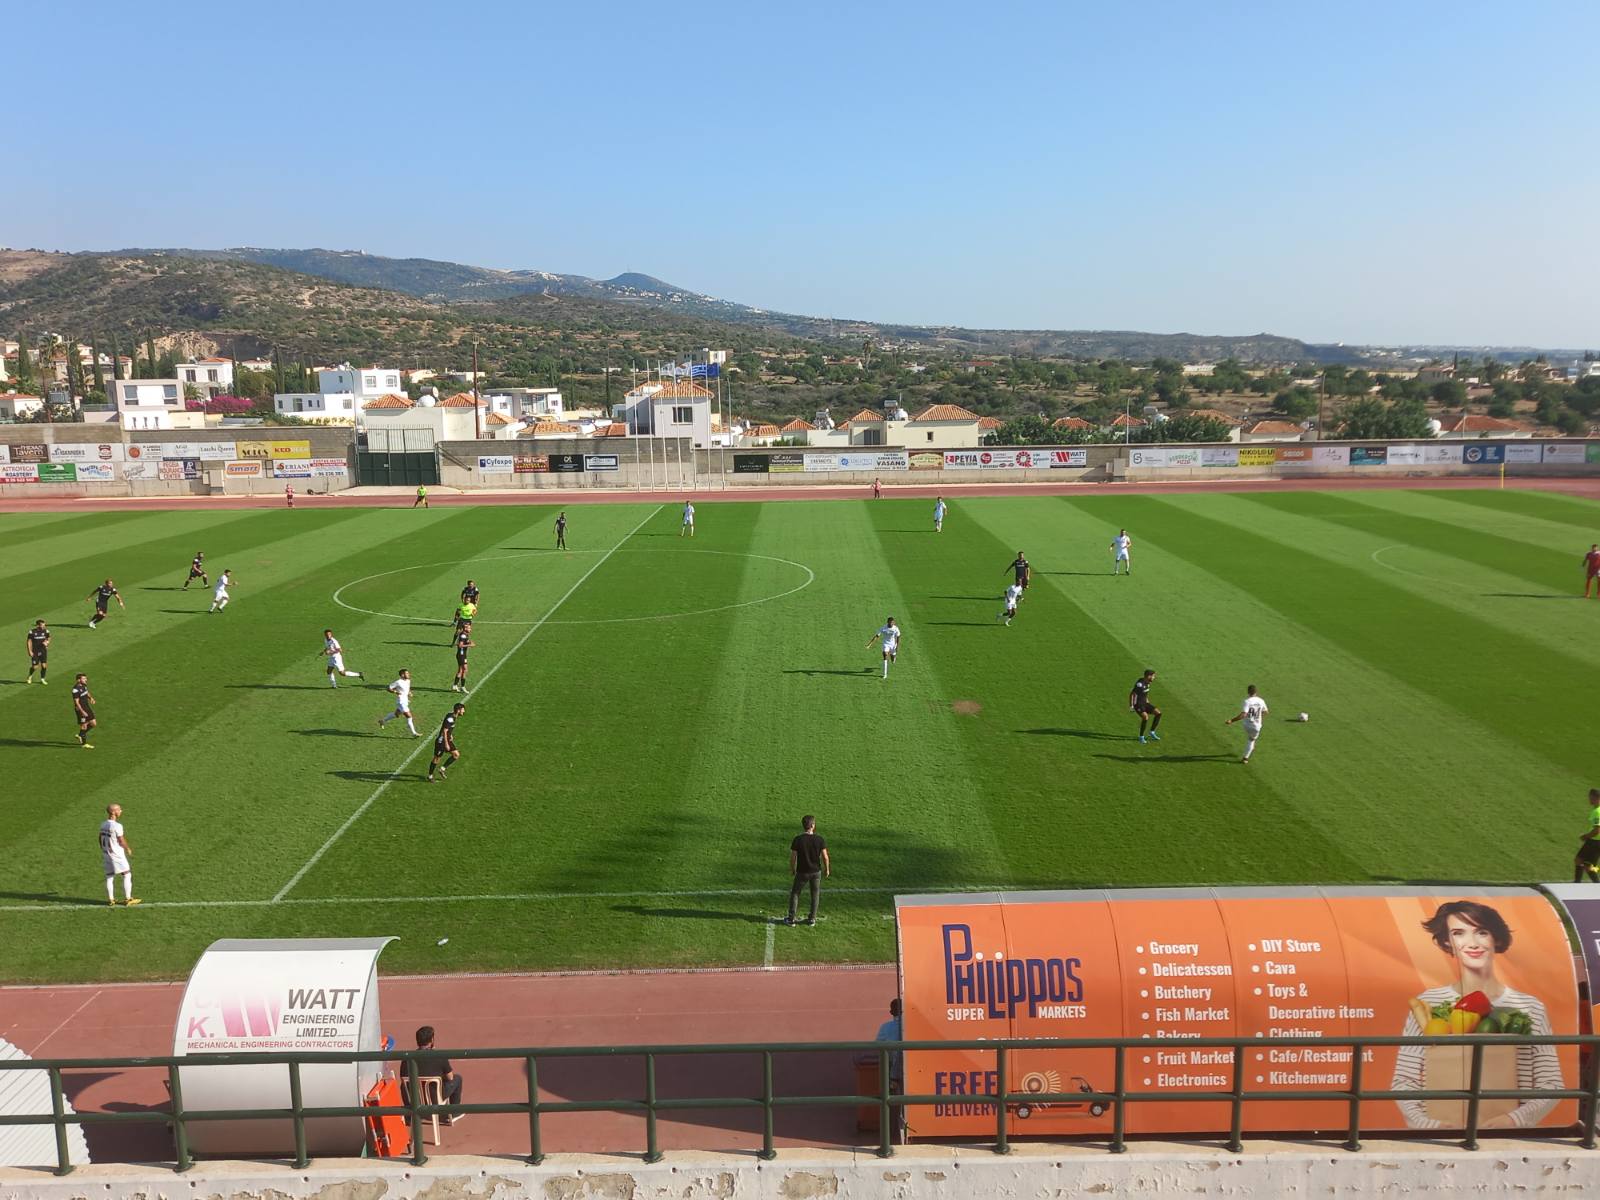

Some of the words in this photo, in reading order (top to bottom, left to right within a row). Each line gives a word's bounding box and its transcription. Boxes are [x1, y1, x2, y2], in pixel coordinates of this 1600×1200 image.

[955, 455, 978, 463] PEYIA
[1150, 941, 1199, 956] Grocery
[1261, 940, 1283, 953] DIY
[1287, 939, 1321, 952] Store
[1153, 963, 1232, 977] Delicatessen
[1265, 961, 1296, 974] Cava
[1155, 985, 1212, 1001] Butchery
[1267, 984, 1295, 999] Toys
[1299, 983, 1308, 997] &
[288, 989, 360, 1010] WATT
[947, 1008, 984, 1021] SUPER
[1038, 1006, 1086, 1019] MARKETS
[1156, 1008, 1181, 1021] Fish
[1185, 1007, 1230, 1021] Market
[1269, 1006, 1335, 1019] Decorative
[1339, 1005, 1374, 1019] items
[282, 1015, 355, 1025] ENGINEERING
[296, 1027, 337, 1038] LIMITED
[1269, 1028, 1323, 1038] Clothing
[187, 1041, 239, 1049] MECHANICAL
[240, 1041, 293, 1049] ENGINEERING
[295, 1040, 354, 1049] CONTRACTORS
[1157, 1051, 1187, 1065] Fruit
[1191, 1050, 1235, 1064] Market
[1269, 1049, 1374, 1063] Cafe/Restaurnt
[935, 1071, 1000, 1095] FREE
[1158, 1072, 1227, 1087] Electronics
[1270, 1071, 1347, 1085] Kitchenware
[935, 1103, 998, 1117] DELIVERY
